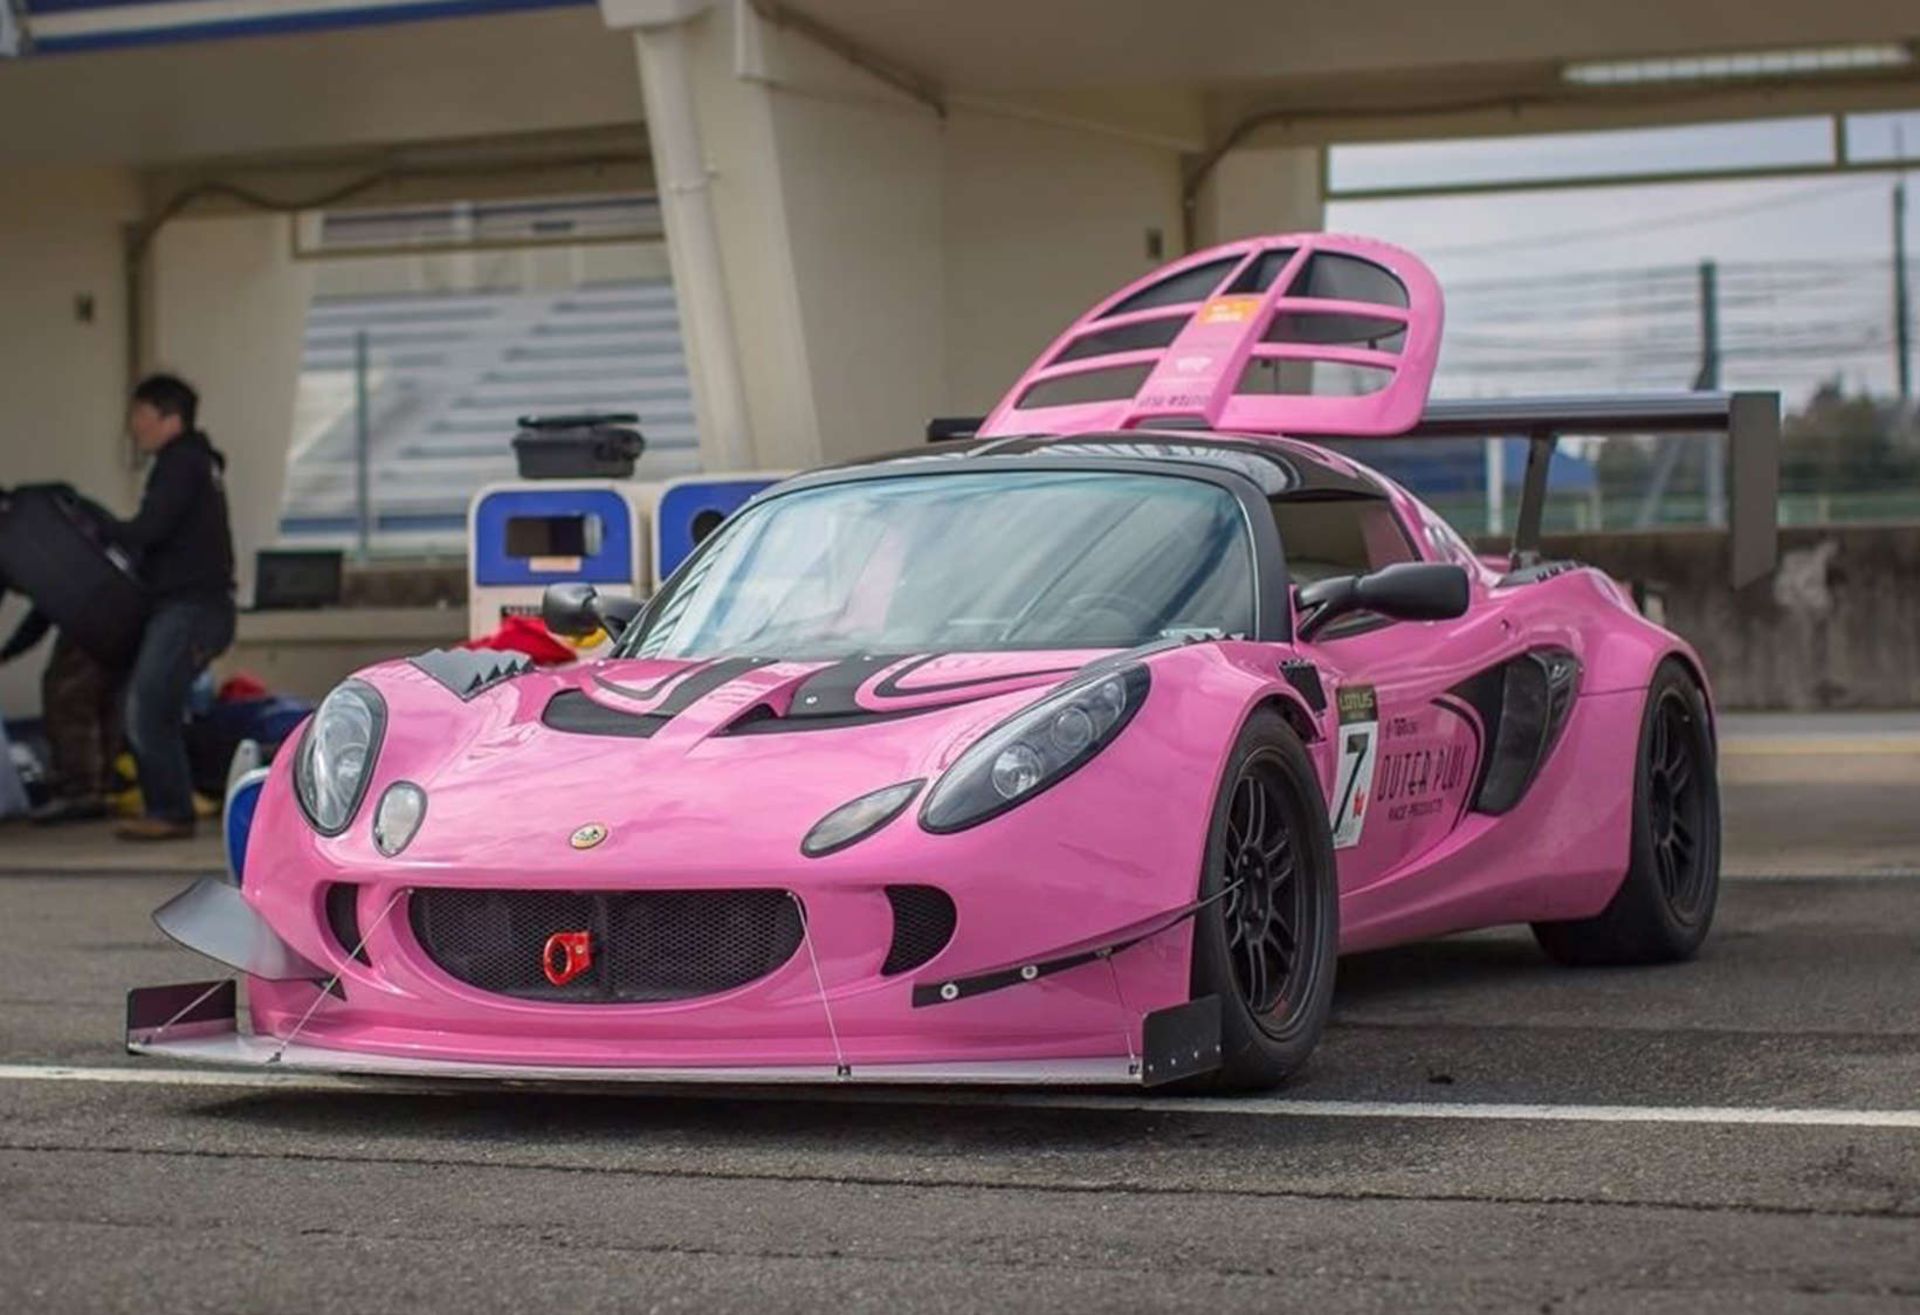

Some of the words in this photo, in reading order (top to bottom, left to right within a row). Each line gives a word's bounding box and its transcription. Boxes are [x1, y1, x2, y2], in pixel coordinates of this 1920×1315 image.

[1339, 692, 1373, 711] LOTUS
[1333, 733, 1370, 834] 7
[1377, 750, 1431, 802] OUTER
